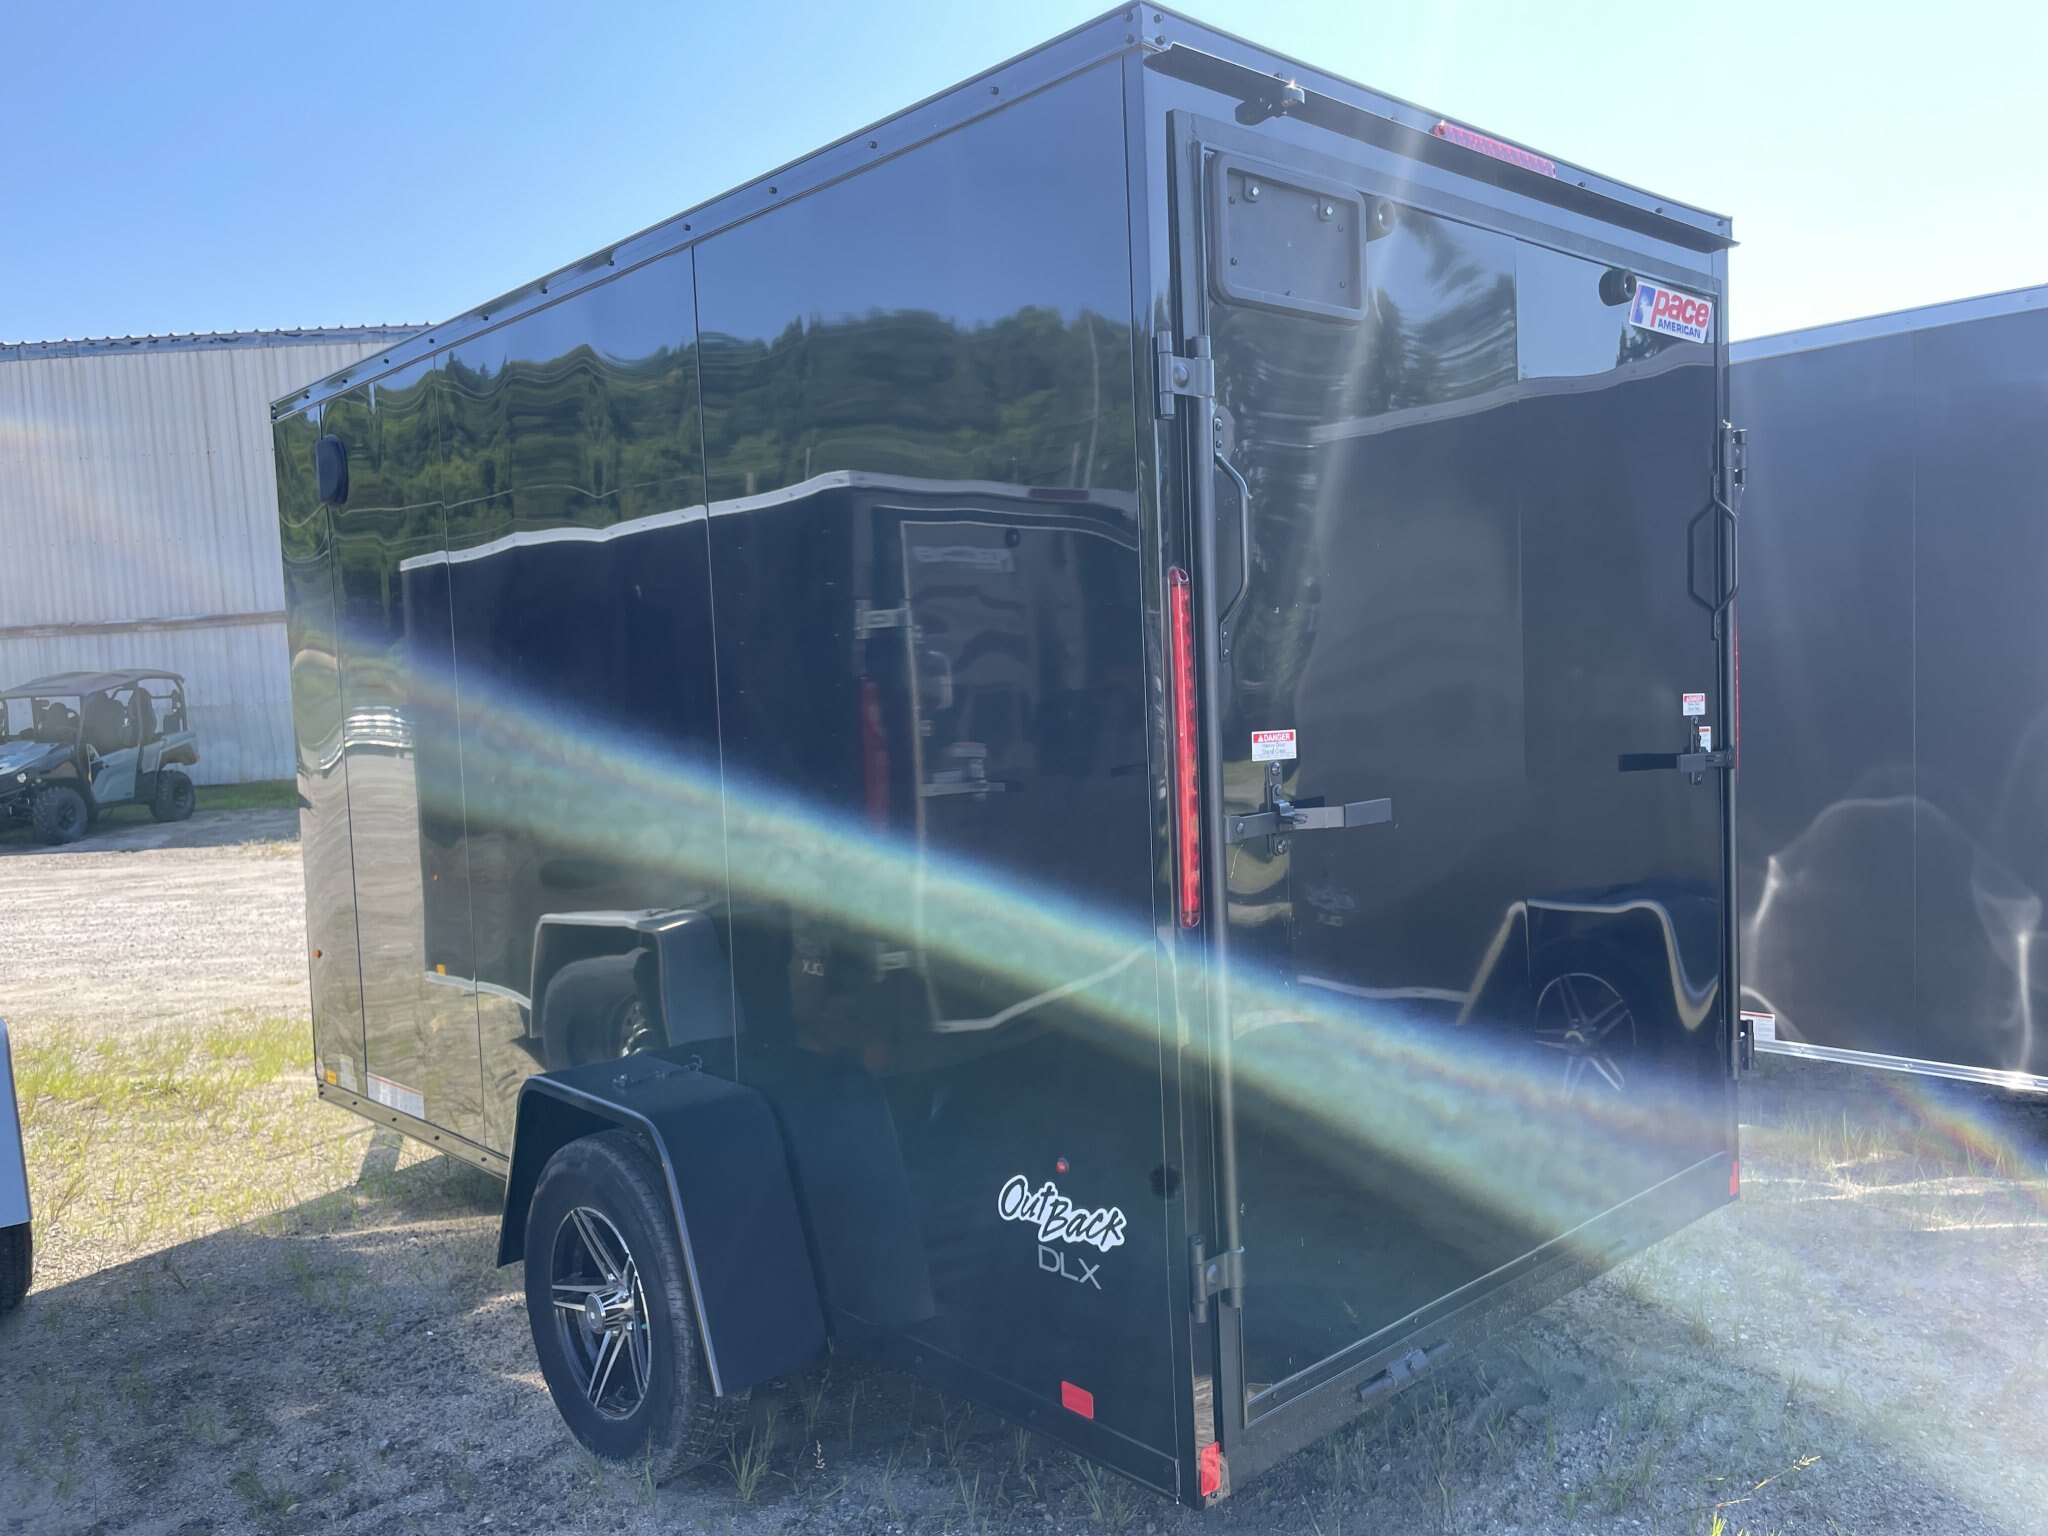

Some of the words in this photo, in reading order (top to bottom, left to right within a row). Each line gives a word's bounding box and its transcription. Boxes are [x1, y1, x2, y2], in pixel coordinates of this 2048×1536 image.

[1650, 289, 1710, 328] pace
[1657, 318, 1701, 339] AMERICAN
[1263, 732, 1291, 742] DANGER
[1038, 1244, 1102, 1290] DLX
